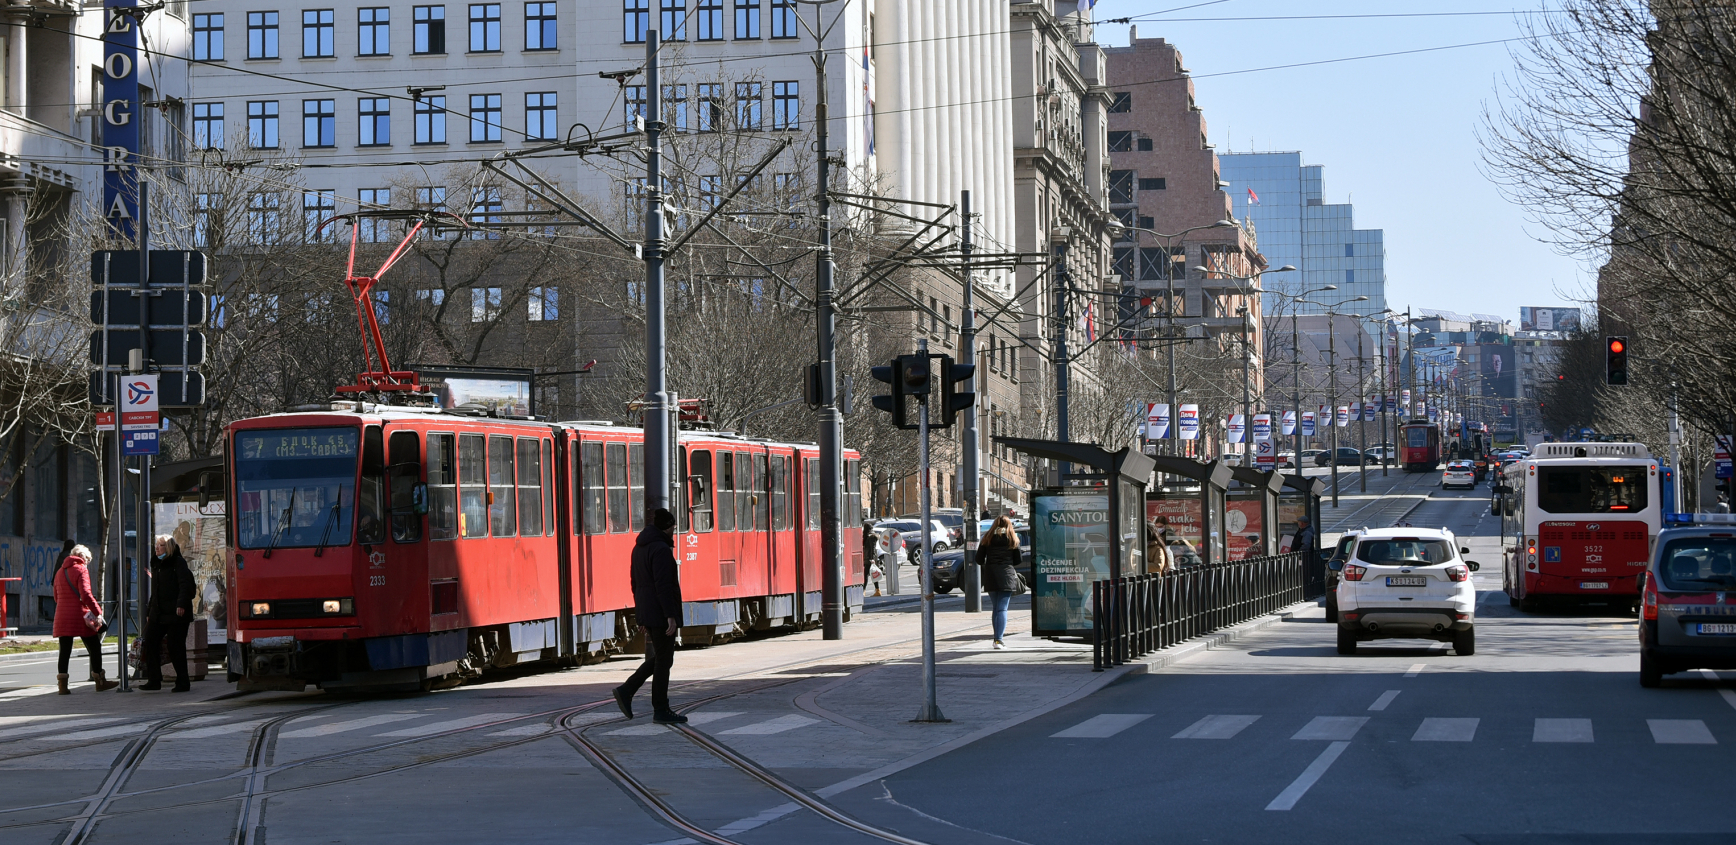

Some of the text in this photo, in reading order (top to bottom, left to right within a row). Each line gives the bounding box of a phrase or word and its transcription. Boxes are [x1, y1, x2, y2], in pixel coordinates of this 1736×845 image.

[254, 435, 344, 458] 7 БЛОК 45
[1051, 512, 1110, 523] SANYTOL
[370, 576, 385, 586] 2333
[1703, 624, 1712, 632] BG
